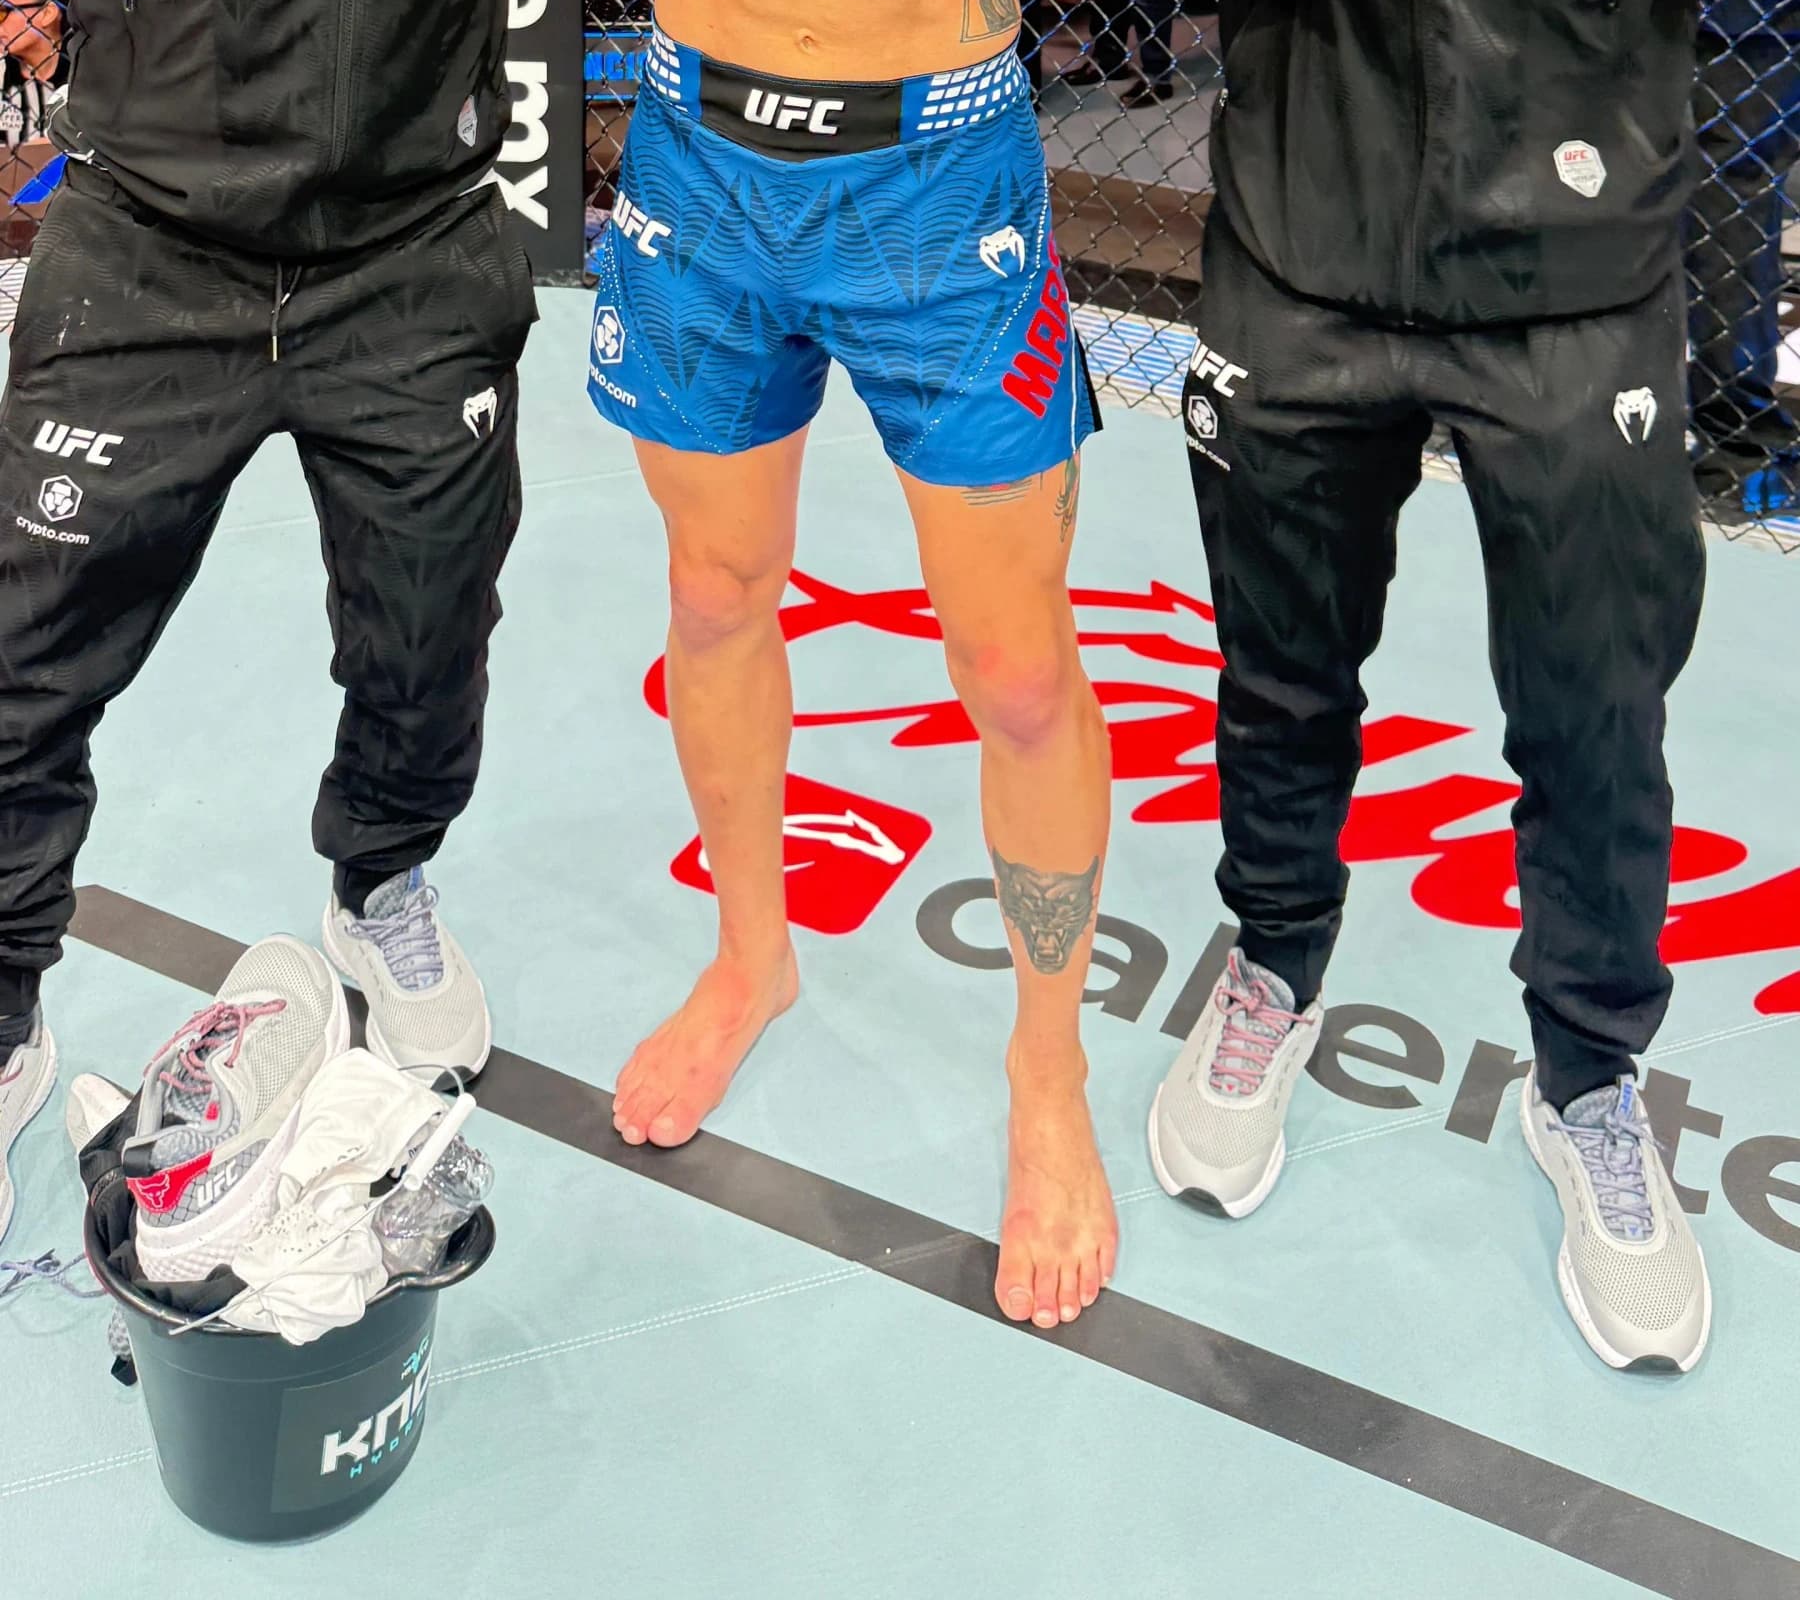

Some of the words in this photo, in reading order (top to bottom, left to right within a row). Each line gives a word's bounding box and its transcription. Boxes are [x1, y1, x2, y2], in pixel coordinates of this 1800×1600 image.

[744, 88, 845, 135] UFC
[1563, 149, 1590, 161] UFC
[612, 189, 673, 258] UFC
[33, 420, 125, 466] UFC
[16, 515, 91, 545] crypto.com
[196, 1158, 238, 1208] UFC
